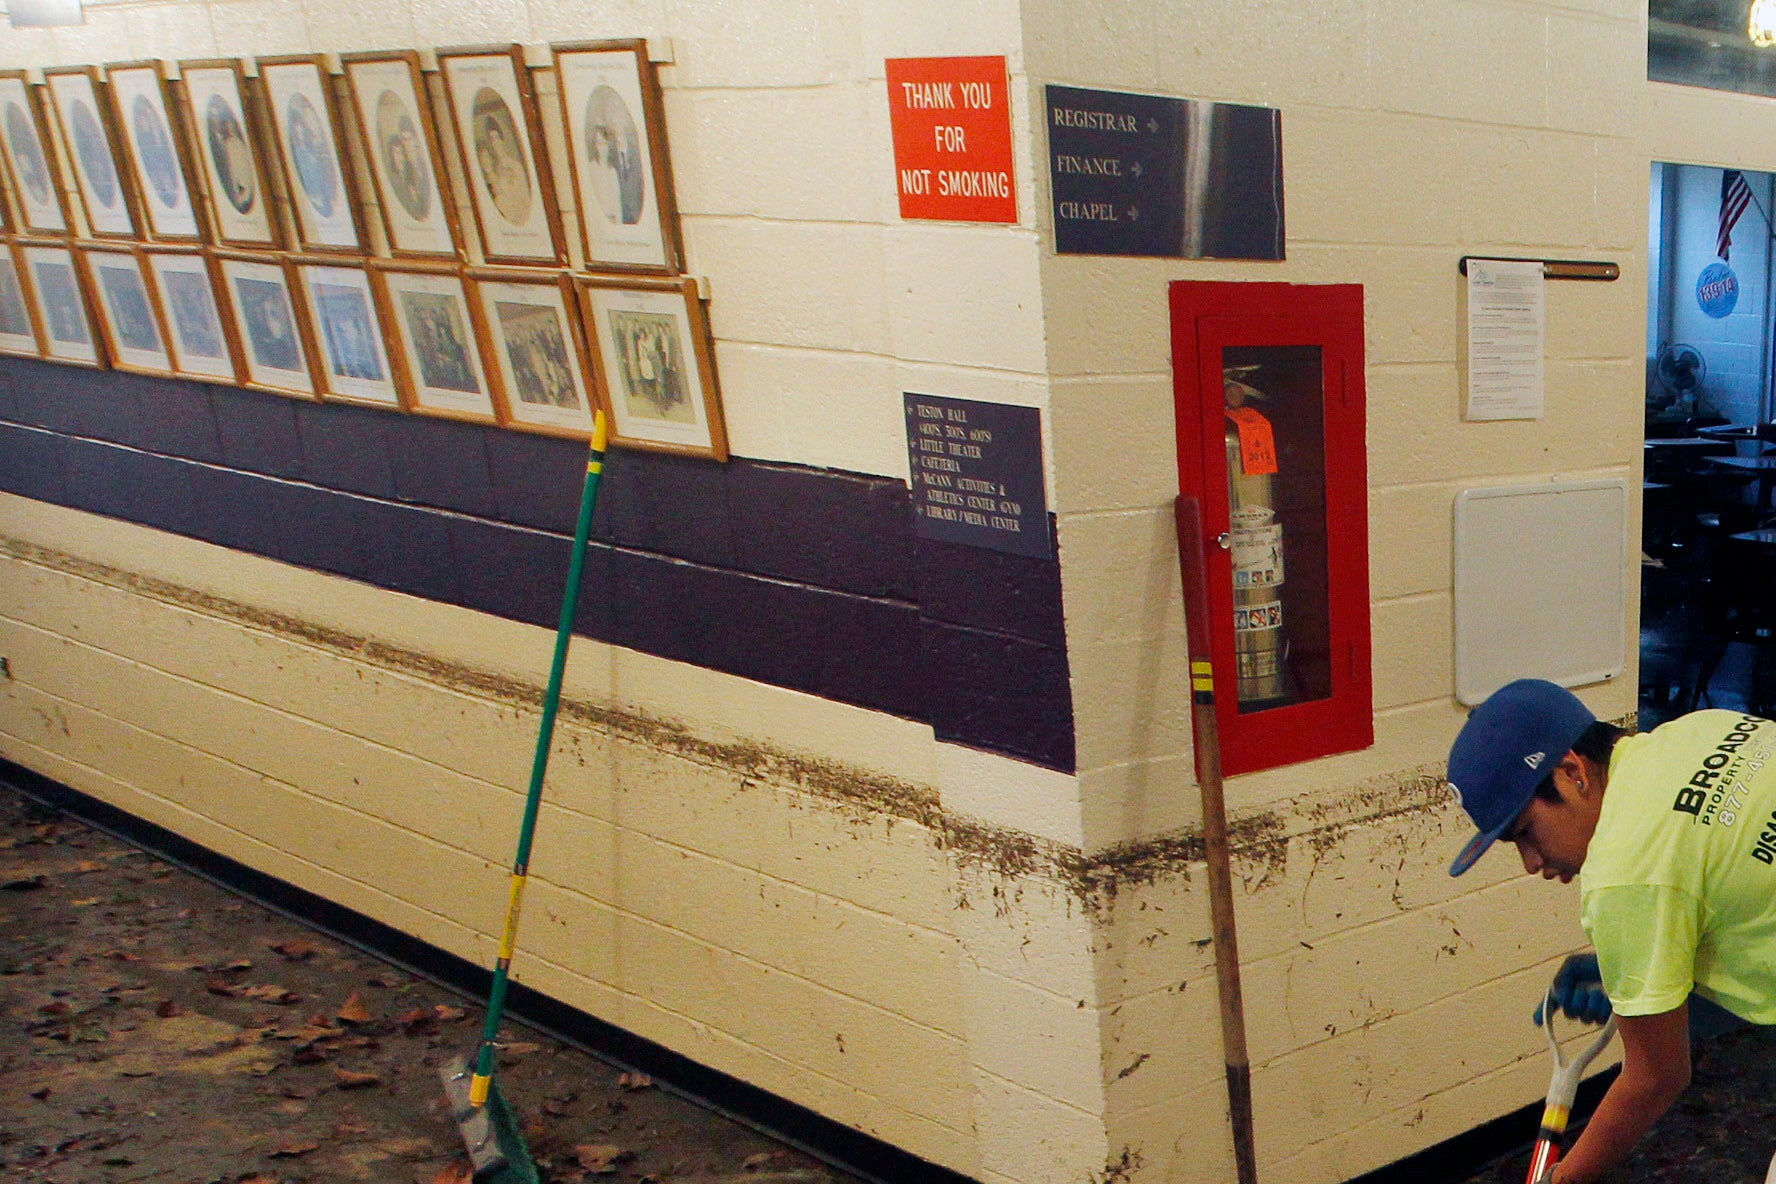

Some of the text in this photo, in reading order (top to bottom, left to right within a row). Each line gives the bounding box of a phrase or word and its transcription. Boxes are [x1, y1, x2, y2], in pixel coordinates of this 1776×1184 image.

[902, 82, 992, 110] THANK YOU
[1053, 108, 1138, 133] REGISTRAR
[934, 126, 966, 153] FOR
[1056, 155, 1122, 177] FINANCE
[901, 170, 1009, 199] NOT SMOKING
[1059, 202, 1118, 222] CHAPEL
[948, 409, 967, 422] HALL
[920, 438, 983, 459] LITTLE THEATER
[921, 456, 961, 473] CAFETERIA
[927, 490, 964, 506] ATHLETICS
[967, 496, 997, 512] CENTER
[991, 516, 1021, 532] CENTER
[1702, 755, 1746, 826] PROPERTY
